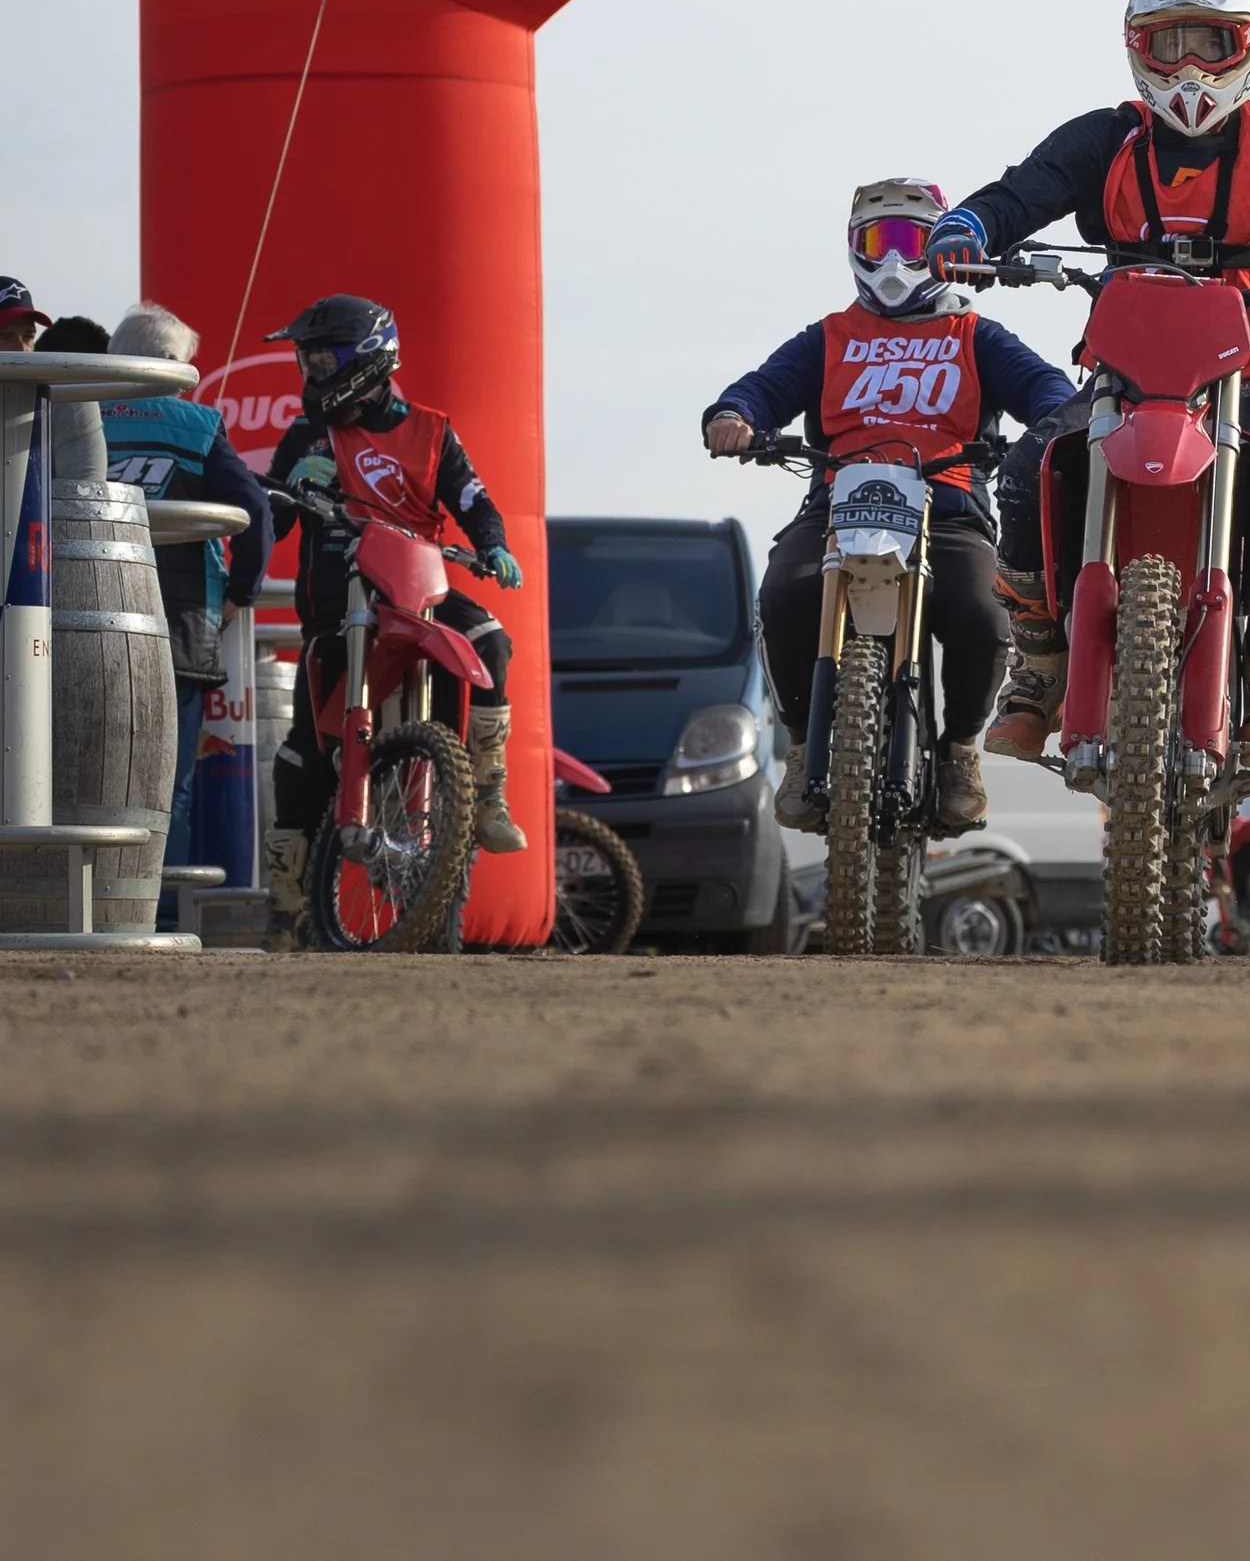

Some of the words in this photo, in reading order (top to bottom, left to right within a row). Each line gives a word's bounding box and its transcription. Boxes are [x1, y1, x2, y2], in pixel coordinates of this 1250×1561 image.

[843, 336, 960, 363] DESMO
[841, 361, 961, 416] 450
[214, 395, 303, 430] DUC
[832, 510, 919, 530] BUNKER
